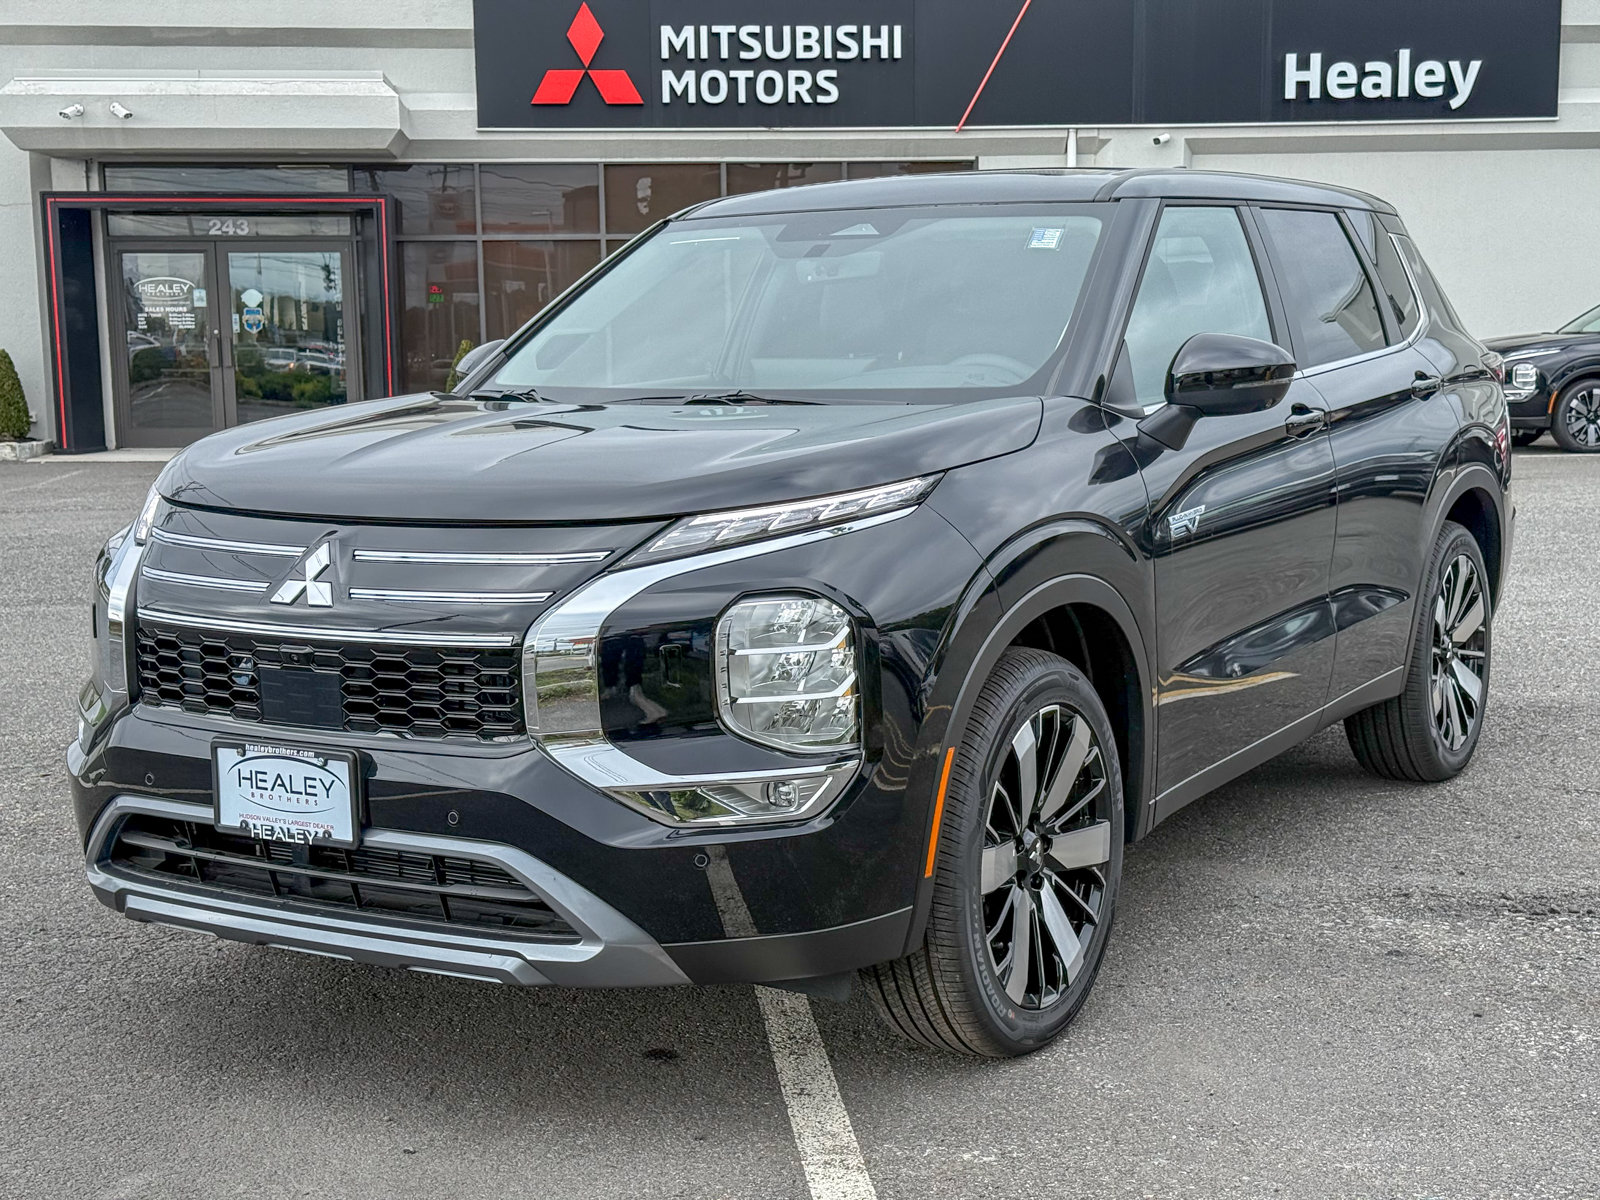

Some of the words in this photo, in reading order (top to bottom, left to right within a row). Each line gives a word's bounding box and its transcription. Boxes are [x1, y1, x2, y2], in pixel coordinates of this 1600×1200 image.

[660, 24, 903, 61] MITSUBISHI
[661, 69, 840, 105] MOTORS
[1284, 48, 1482, 111] Healey
[208, 219, 250, 235] 243
[138, 283, 190, 293] HEALEY
[1170, 515, 1200, 540] EV
[245, 744, 315, 758] healeybrothers.com
[237, 768, 336, 799] HEALEY
[250, 792, 319, 806] BROTHERS
[238, 813, 262, 821] HUDSON
[262, 816, 287, 825] VALLEY'S
[288, 819, 312, 828] LARGEST
[312, 822, 334, 831] DEALER
[250, 823, 318, 846] HEALEY
